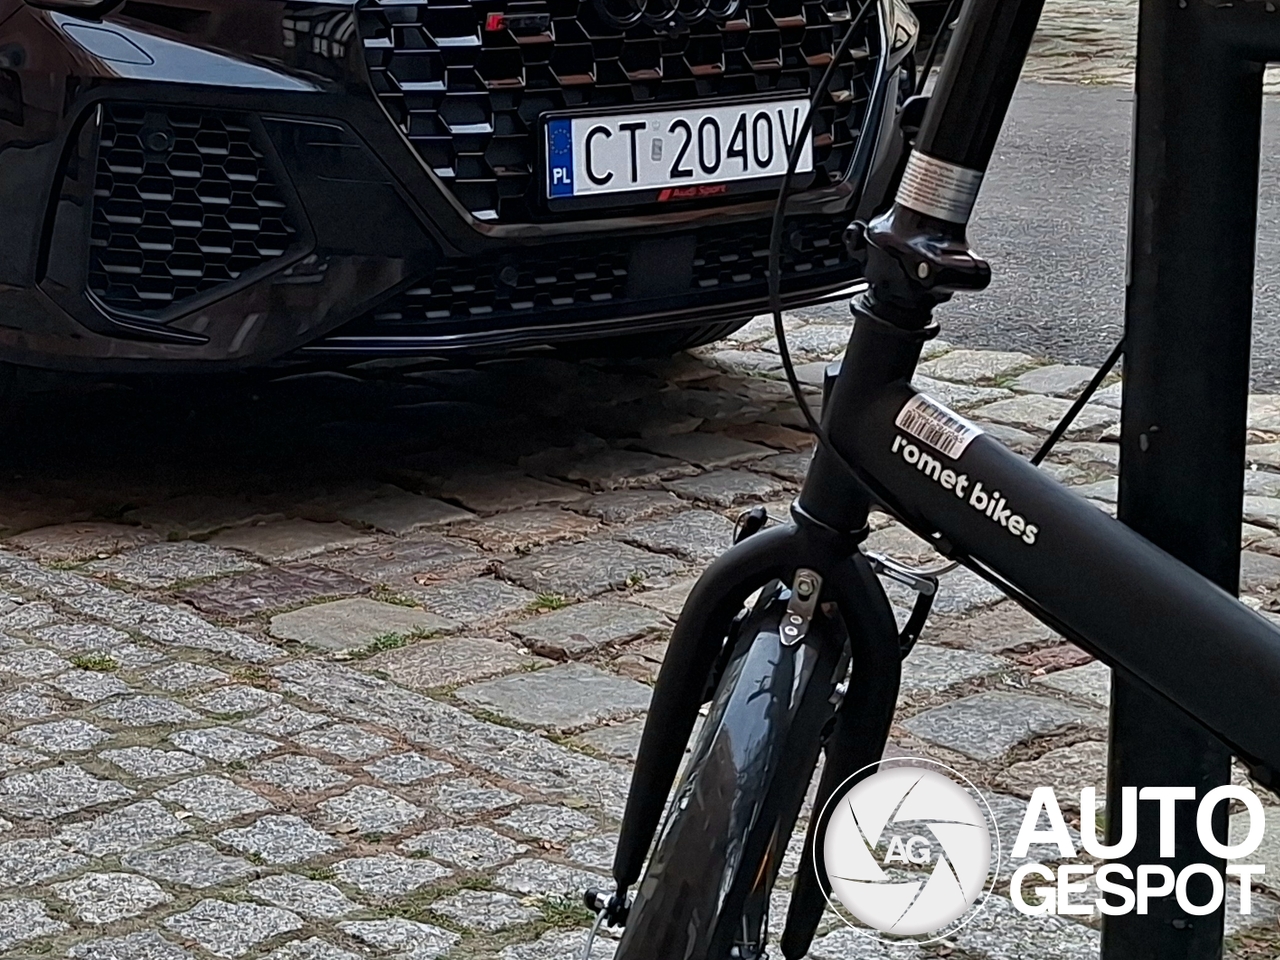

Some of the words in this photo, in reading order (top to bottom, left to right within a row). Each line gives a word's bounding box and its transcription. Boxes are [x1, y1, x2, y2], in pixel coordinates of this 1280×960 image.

[552, 167, 571, 185] PL
[585, 121, 647, 186] CT
[668, 107, 800, 179] 2040V
[891, 435, 969, 499] romet
[969, 482, 1039, 545] bikes
